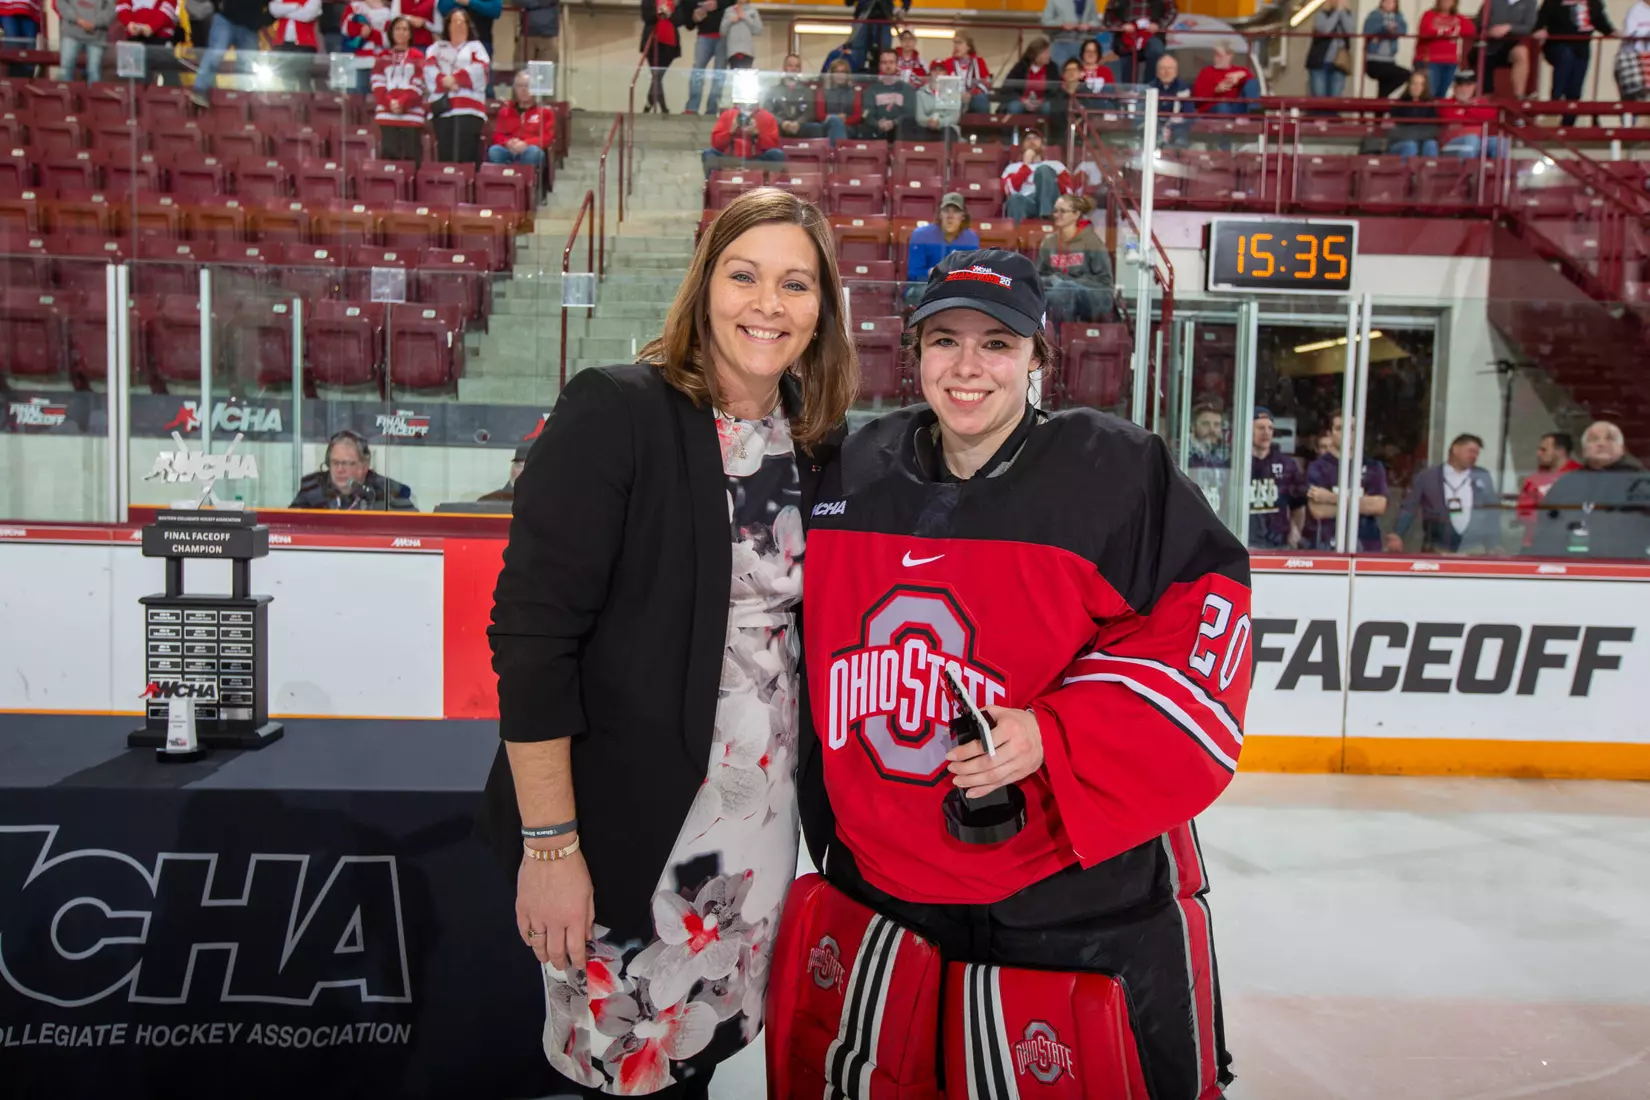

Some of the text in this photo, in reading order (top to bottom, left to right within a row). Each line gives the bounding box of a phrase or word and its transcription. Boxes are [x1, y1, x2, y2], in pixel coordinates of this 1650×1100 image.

[1237, 233, 1348, 280] 15:35
[184, 401, 283, 432] WCHA
[164, 531, 231, 542] FINAL FACEOFF
[172, 544, 223, 554] CHAMPION
[1189, 593, 1251, 692] 20
[1251, 617, 1637, 697] FACEOFF
[151, 681, 216, 699] WCHA
[828, 649, 900, 751] OHIO
[0, 825, 412, 1008] CHA
[0, 1022, 412, 1049] LLEGIATE HOCKEY ASSOCIATION
